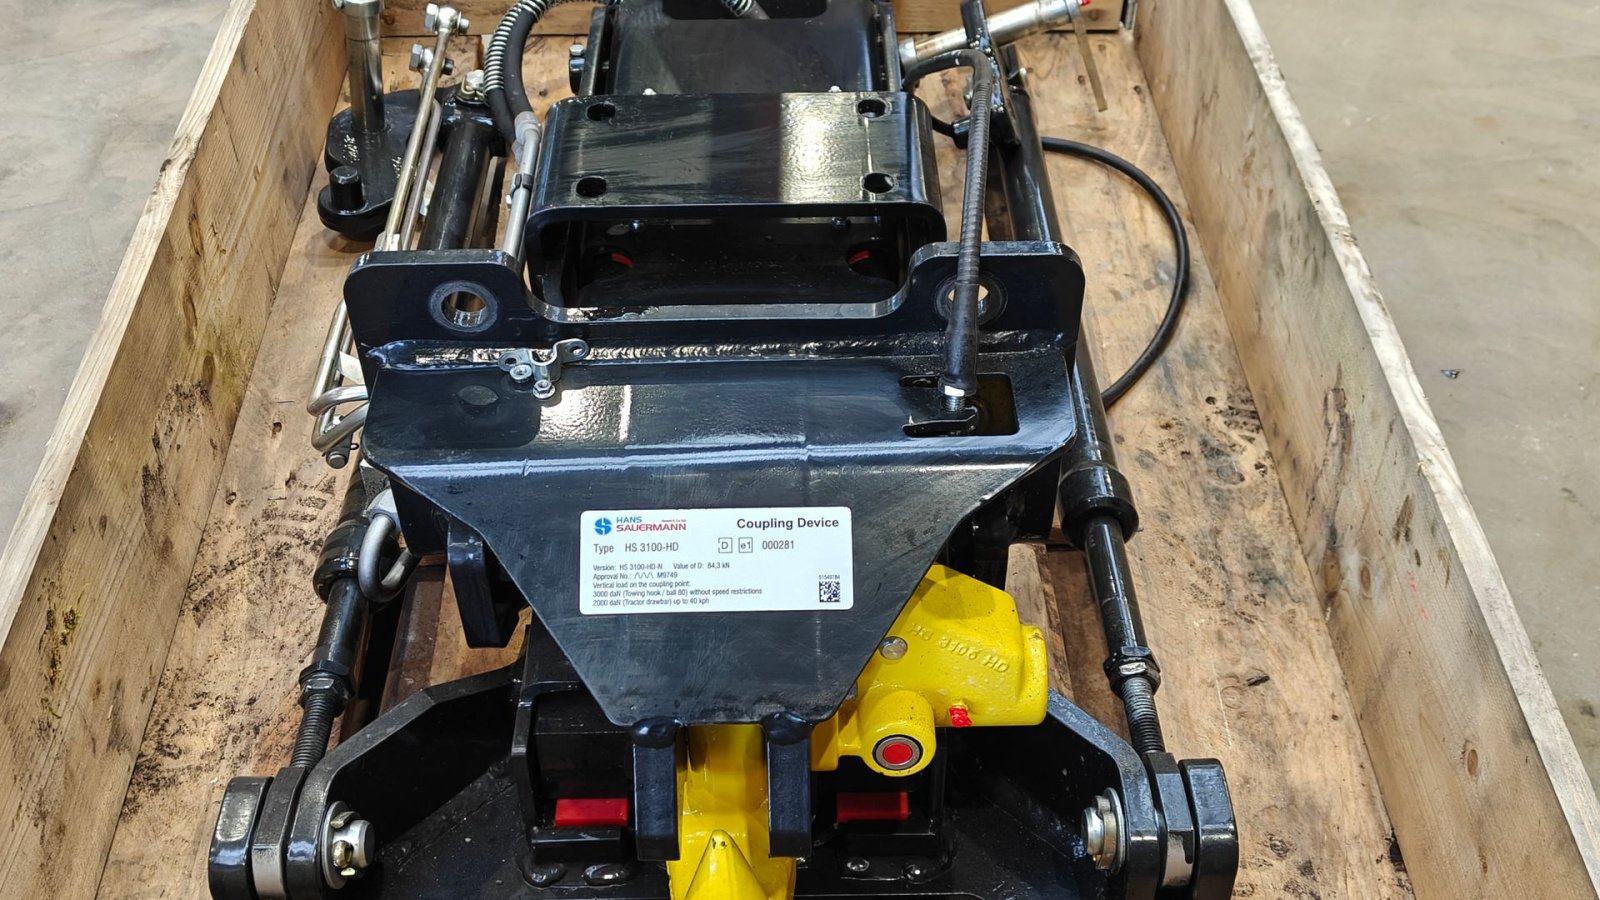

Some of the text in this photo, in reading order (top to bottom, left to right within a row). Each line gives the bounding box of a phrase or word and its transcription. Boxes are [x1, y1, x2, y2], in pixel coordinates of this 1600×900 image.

[616, 516, 642, 524] HANS
[737, 517, 839, 531] Coupling Device
[616, 523, 687, 532] SAUERMANN
[594, 542, 679, 555] Type HS 3100-HD
[721, 540, 795, 550] D e1 000281
[619, 563, 628, 571] HS
[629, 563, 663, 571] 3100-HD-N
[673, 562, 689, 570] Value
[592, 573, 618, 581] Approval
[649, 580, 673, 588] coupling
[622, 590, 645, 598] (Towing
[712, 588, 729, 596] speed
[731, 587, 762, 595] restrictions
[622, 599, 644, 607] (Tractor
[645, 598, 672, 607] drawbar)
[698, 597, 710, 605] kph
